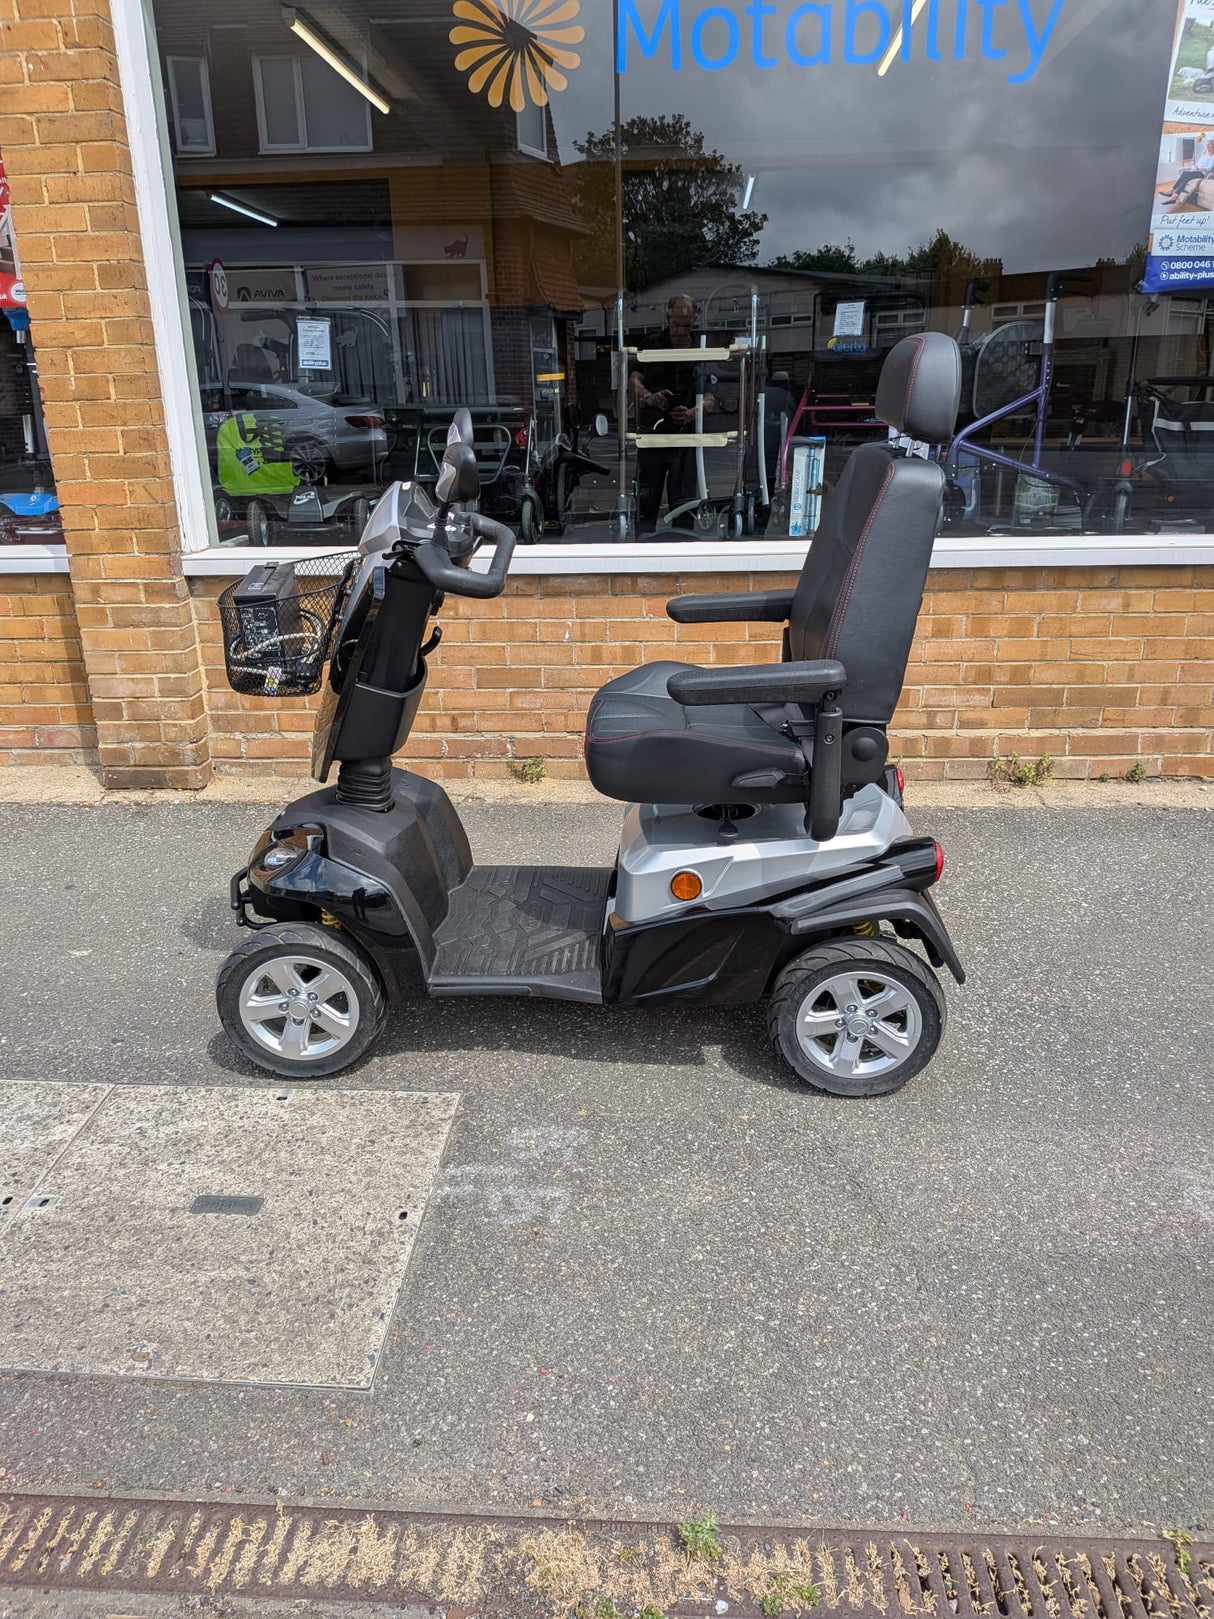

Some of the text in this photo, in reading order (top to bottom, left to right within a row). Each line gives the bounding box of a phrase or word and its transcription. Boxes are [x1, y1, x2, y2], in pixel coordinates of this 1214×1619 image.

[616, 0, 1065, 84] Motability
[1172, 105, 1210, 119] Adventure
[1160, 214, 1210, 229] Put feet up!
[1177, 234, 1214, 244] Motability
[1175, 243, 1206, 251] Scheme
[1170, 261, 1193, 270] 0800
[335, 272, 373, 281] exceptional
[375, 271, 397, 280] desgn
[254, 287, 286, 298] AVIVA
[332, 284, 352, 292] meets
[833, 340, 867, 352] alerta
